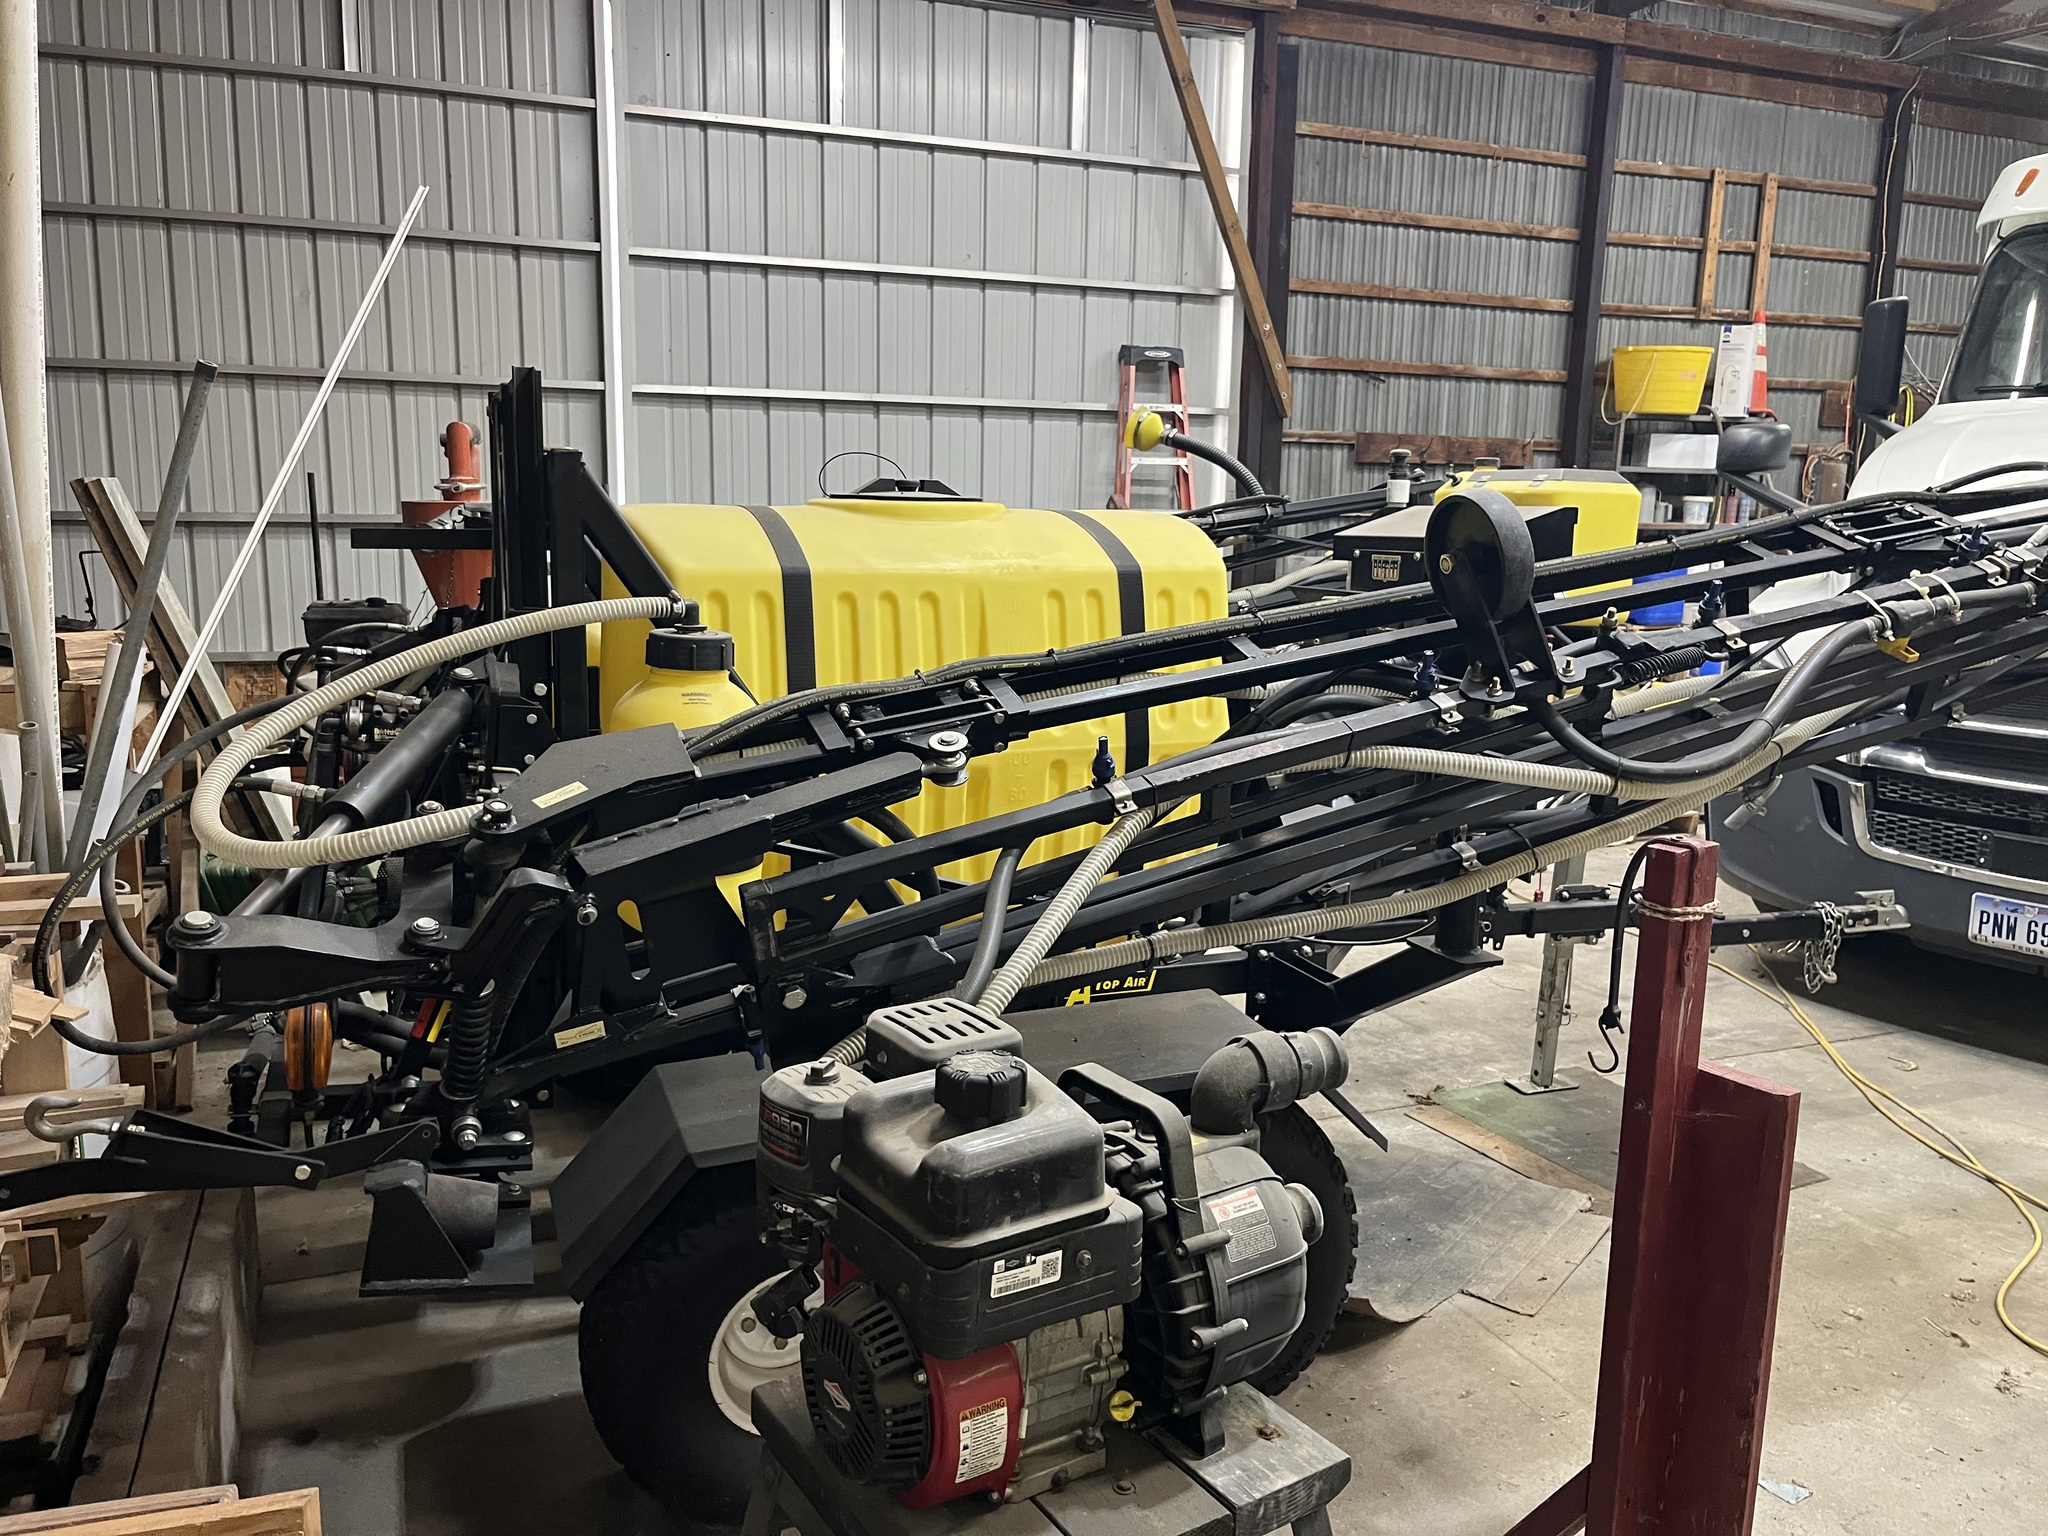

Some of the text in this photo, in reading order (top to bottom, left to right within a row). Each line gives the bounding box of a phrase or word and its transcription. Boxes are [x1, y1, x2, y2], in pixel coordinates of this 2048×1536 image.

[136, 802, 176, 829] WEARGUARD
[113, 832, 129, 846] INCH
[77, 869, 89, 882] SAE
[1978, 909, 2018, 941] PNW
[1123, 976, 1147, 988] AIR
[968, 1398, 1005, 1419] WARNING
